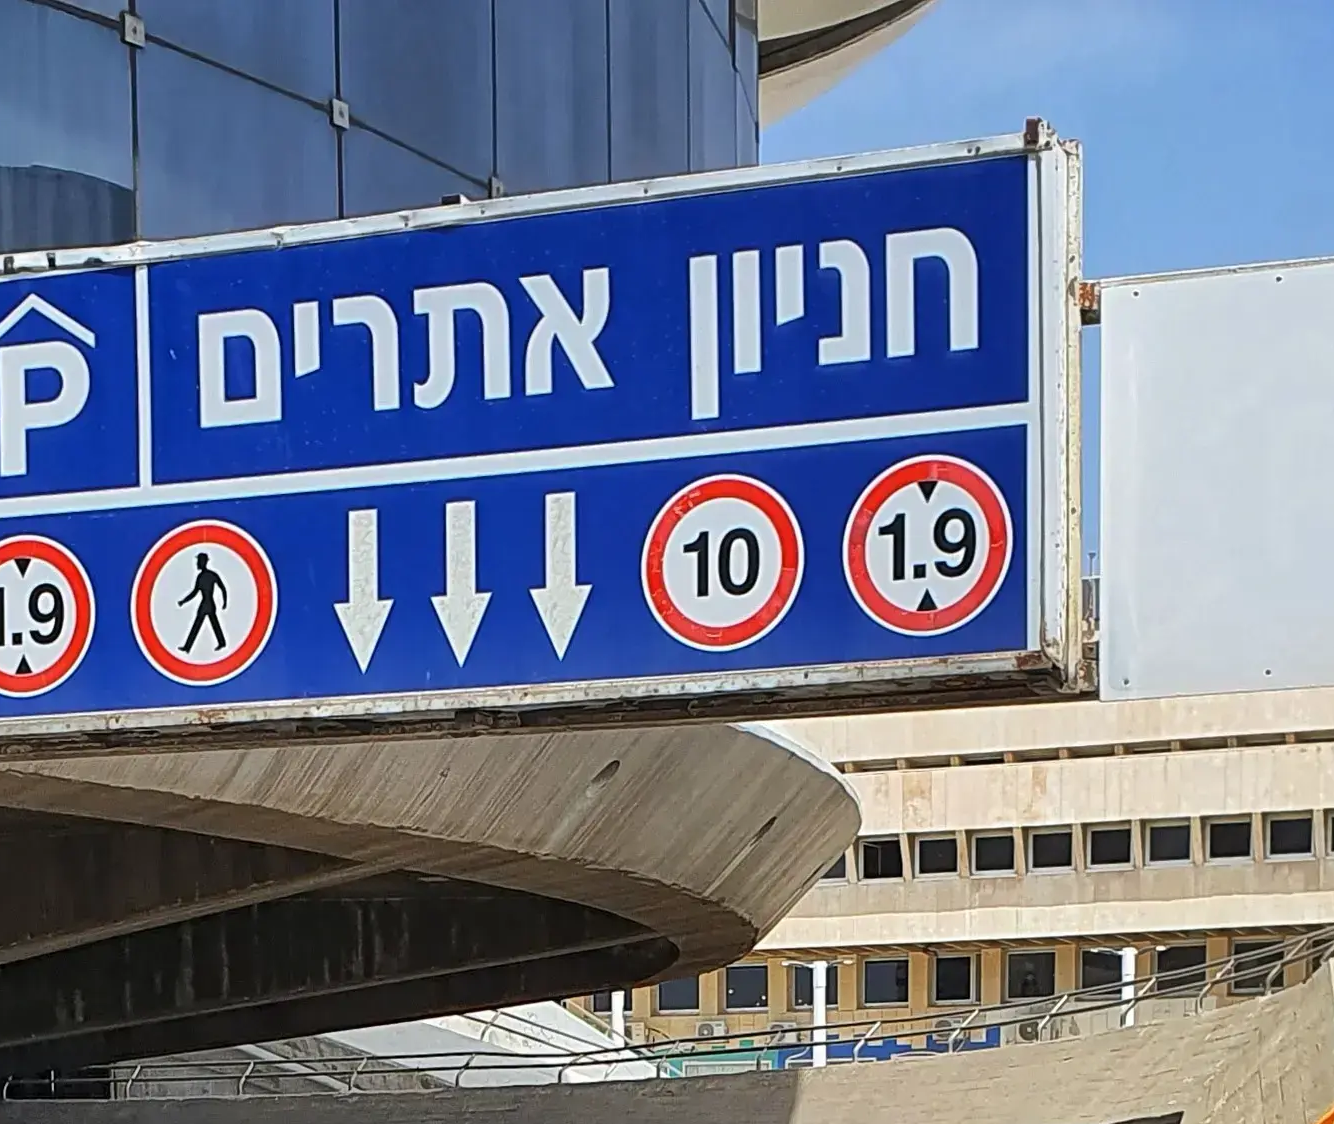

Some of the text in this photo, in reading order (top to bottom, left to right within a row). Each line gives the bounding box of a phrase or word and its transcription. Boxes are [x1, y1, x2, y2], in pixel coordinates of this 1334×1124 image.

[197, 226, 981, 428] חניון אתרים
[683, 527, 760, 598] 10
[877, 507, 977, 581] 1.9
